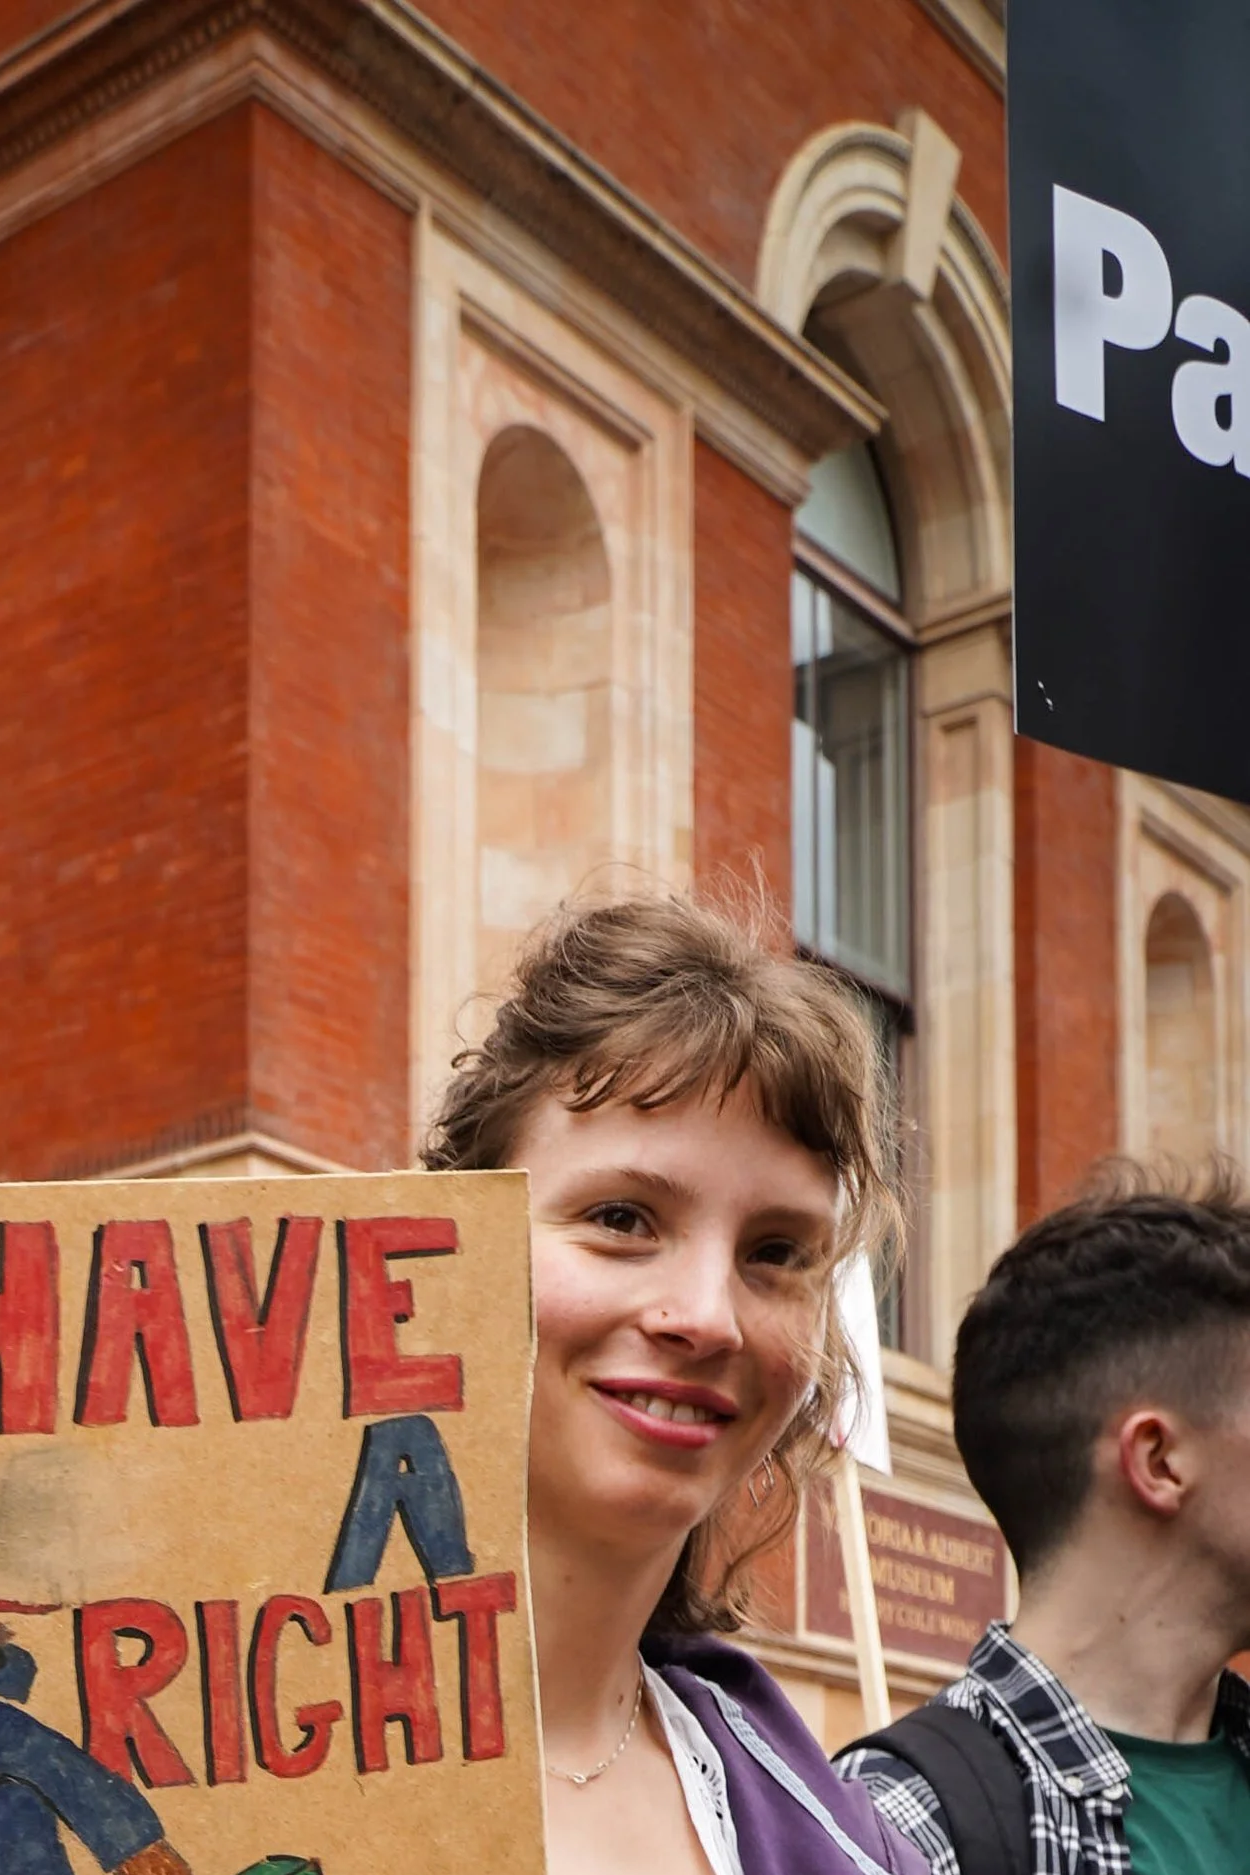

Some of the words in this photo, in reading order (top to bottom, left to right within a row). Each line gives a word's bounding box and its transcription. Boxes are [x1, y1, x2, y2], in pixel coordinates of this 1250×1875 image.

[323, 1414, 474, 1595] A
[870, 1553, 956, 1606] MUSEUM
[73, 1570, 518, 1788] RIGHT
